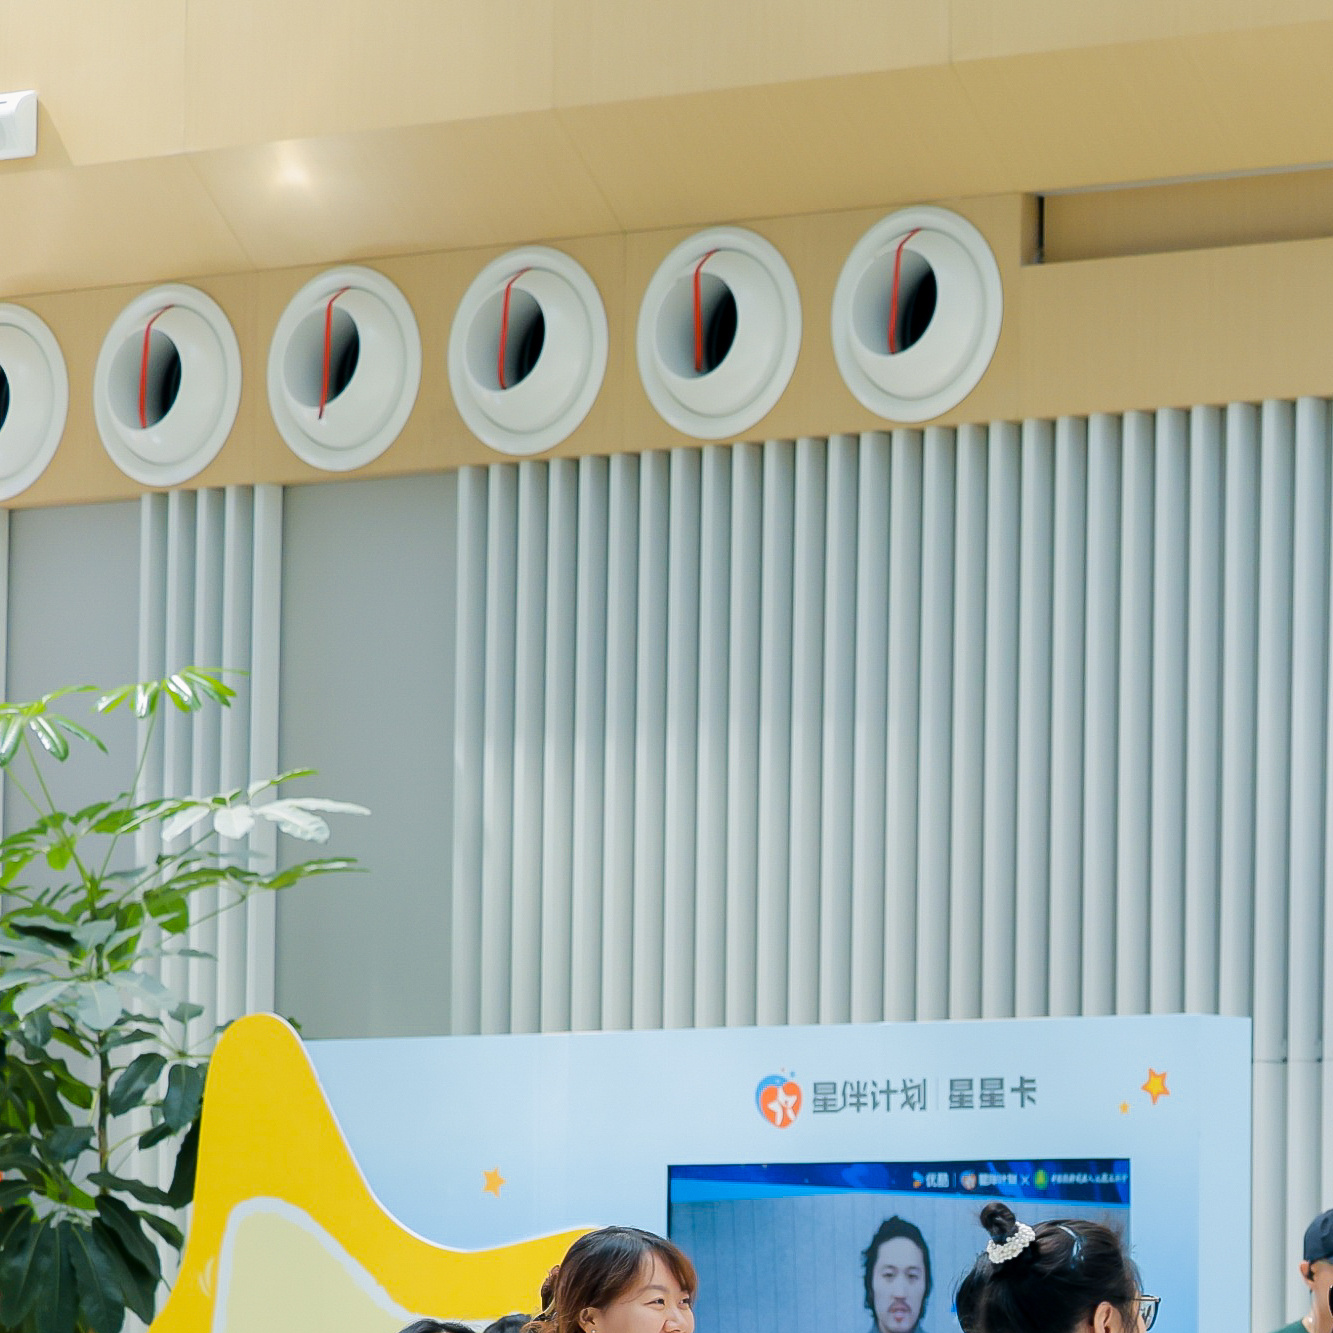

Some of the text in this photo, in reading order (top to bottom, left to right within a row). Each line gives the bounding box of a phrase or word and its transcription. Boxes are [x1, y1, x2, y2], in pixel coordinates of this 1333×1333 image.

[812, 1075, 1037, 1114] 星伴计划 星星卡
